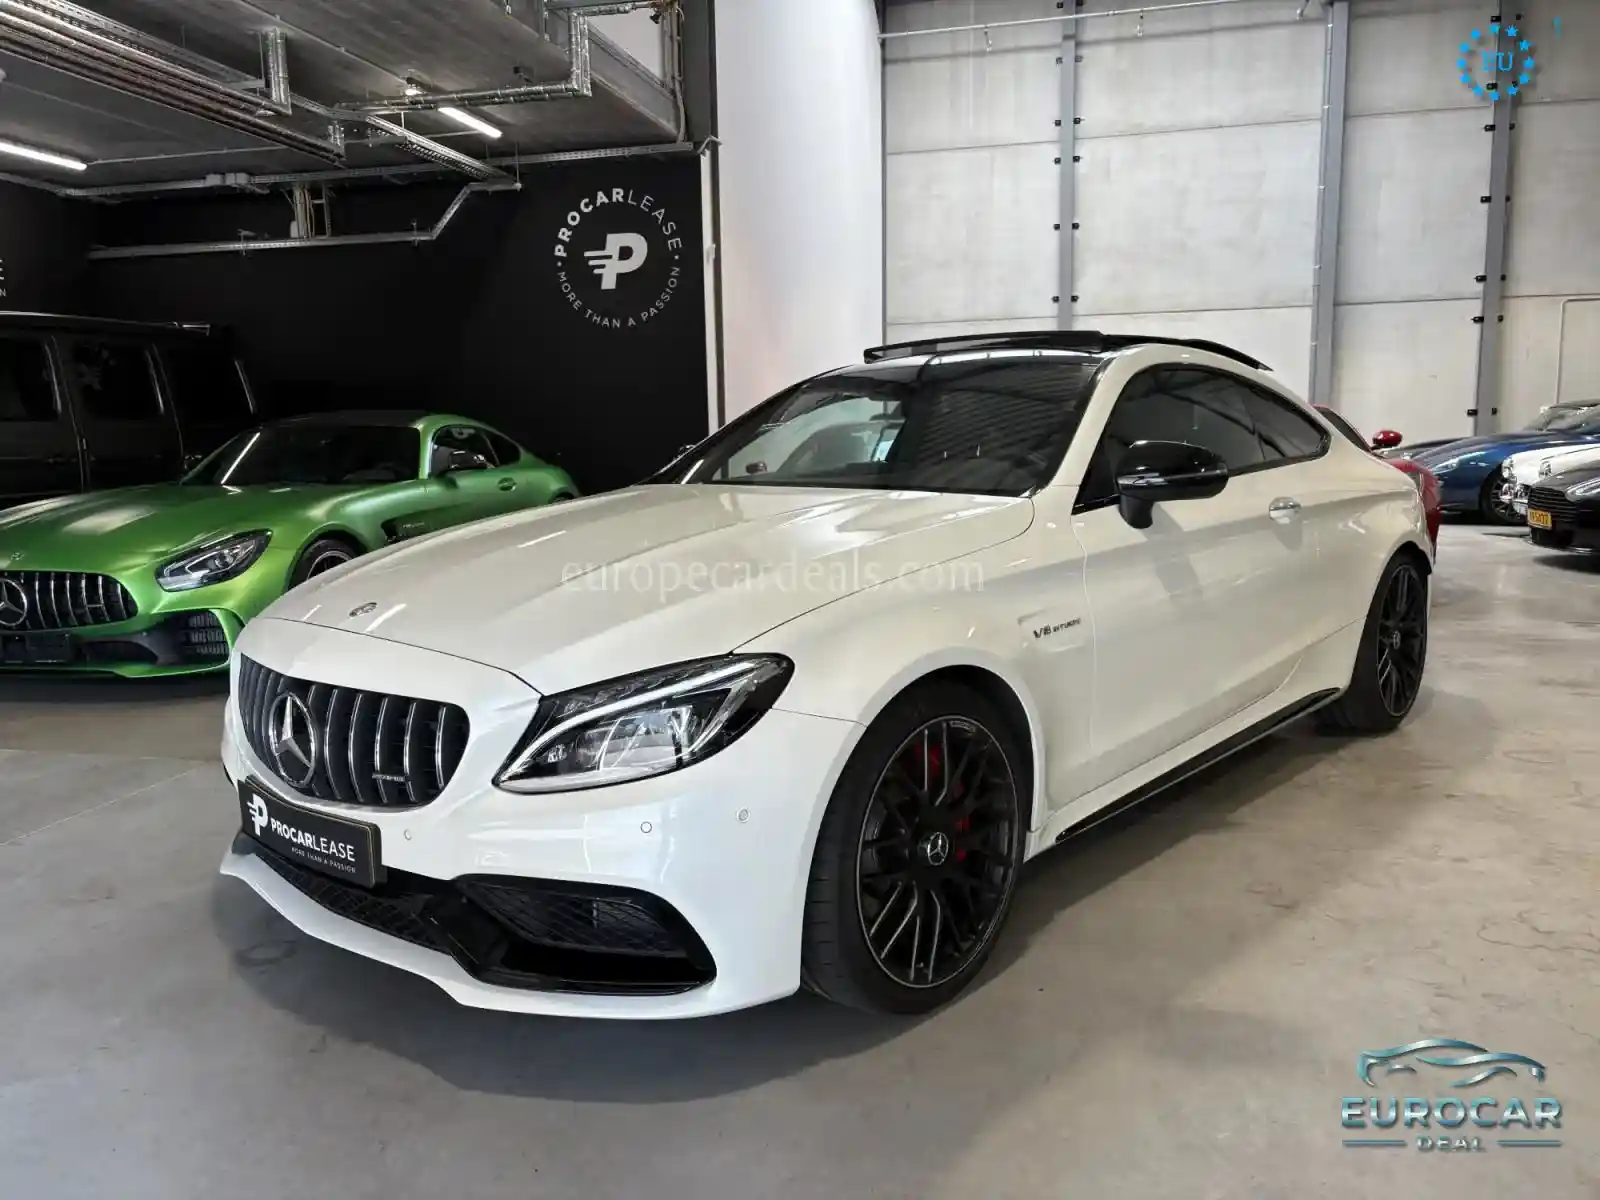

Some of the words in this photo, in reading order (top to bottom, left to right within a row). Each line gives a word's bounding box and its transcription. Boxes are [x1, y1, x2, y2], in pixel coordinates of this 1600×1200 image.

[554, 187, 683, 258] PROCARLEASE
[557, 271, 582, 310] MORE
[584, 308, 621, 328] THAN
[627, 317, 636, 327] A
[640, 266, 680, 322] PASSION
[270, 817, 356, 862] PROCARLEASE
[329, 859, 356, 874] PASSION
